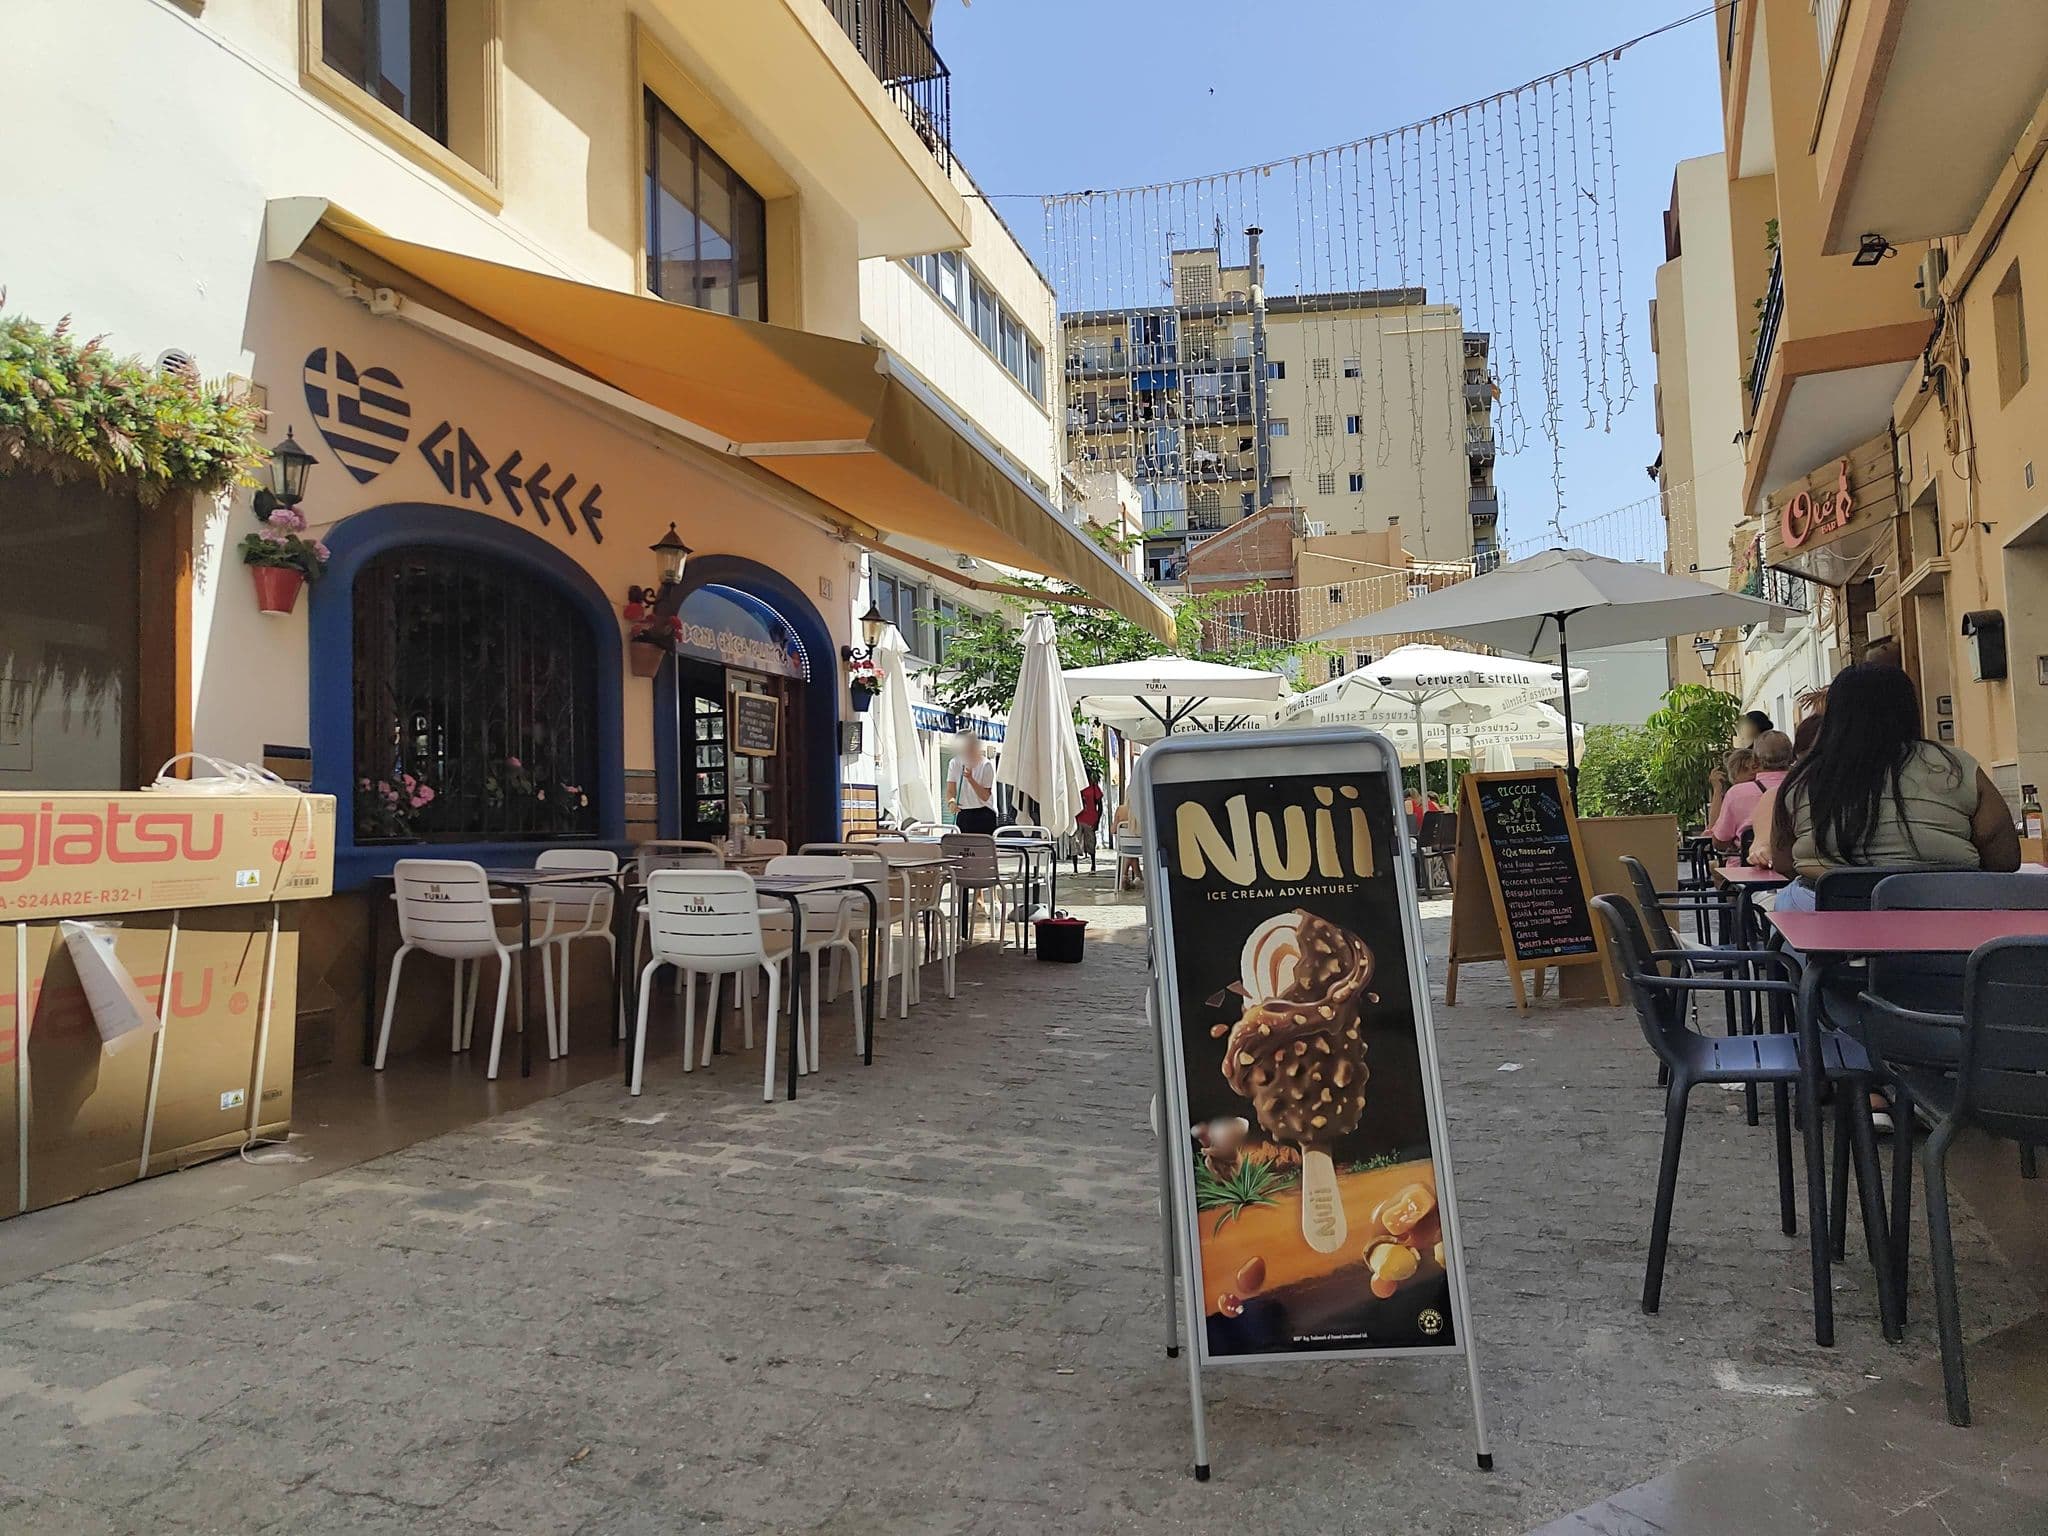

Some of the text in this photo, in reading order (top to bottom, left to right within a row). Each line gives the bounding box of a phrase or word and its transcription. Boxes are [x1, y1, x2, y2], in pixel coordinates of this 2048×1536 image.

[418, 421, 603, 545] GREECE
[1781, 491, 1834, 549] Olé
[1821, 521, 1837, 535] BAR
[1415, 672, 1530, 687] Cerveza Estrella
[1497, 785, 1537, 797] PICCOLI
[1176, 785, 1374, 886] Nuii
[1505, 823, 1542, 835] PIACERI
[0, 802, 224, 882] giatsu
[424, 892, 450, 901] TURIA
[1207, 891, 1227, 900] ICE
[1232, 889, 1274, 900] CREAM
[683, 904, 715, 913] TURIA
